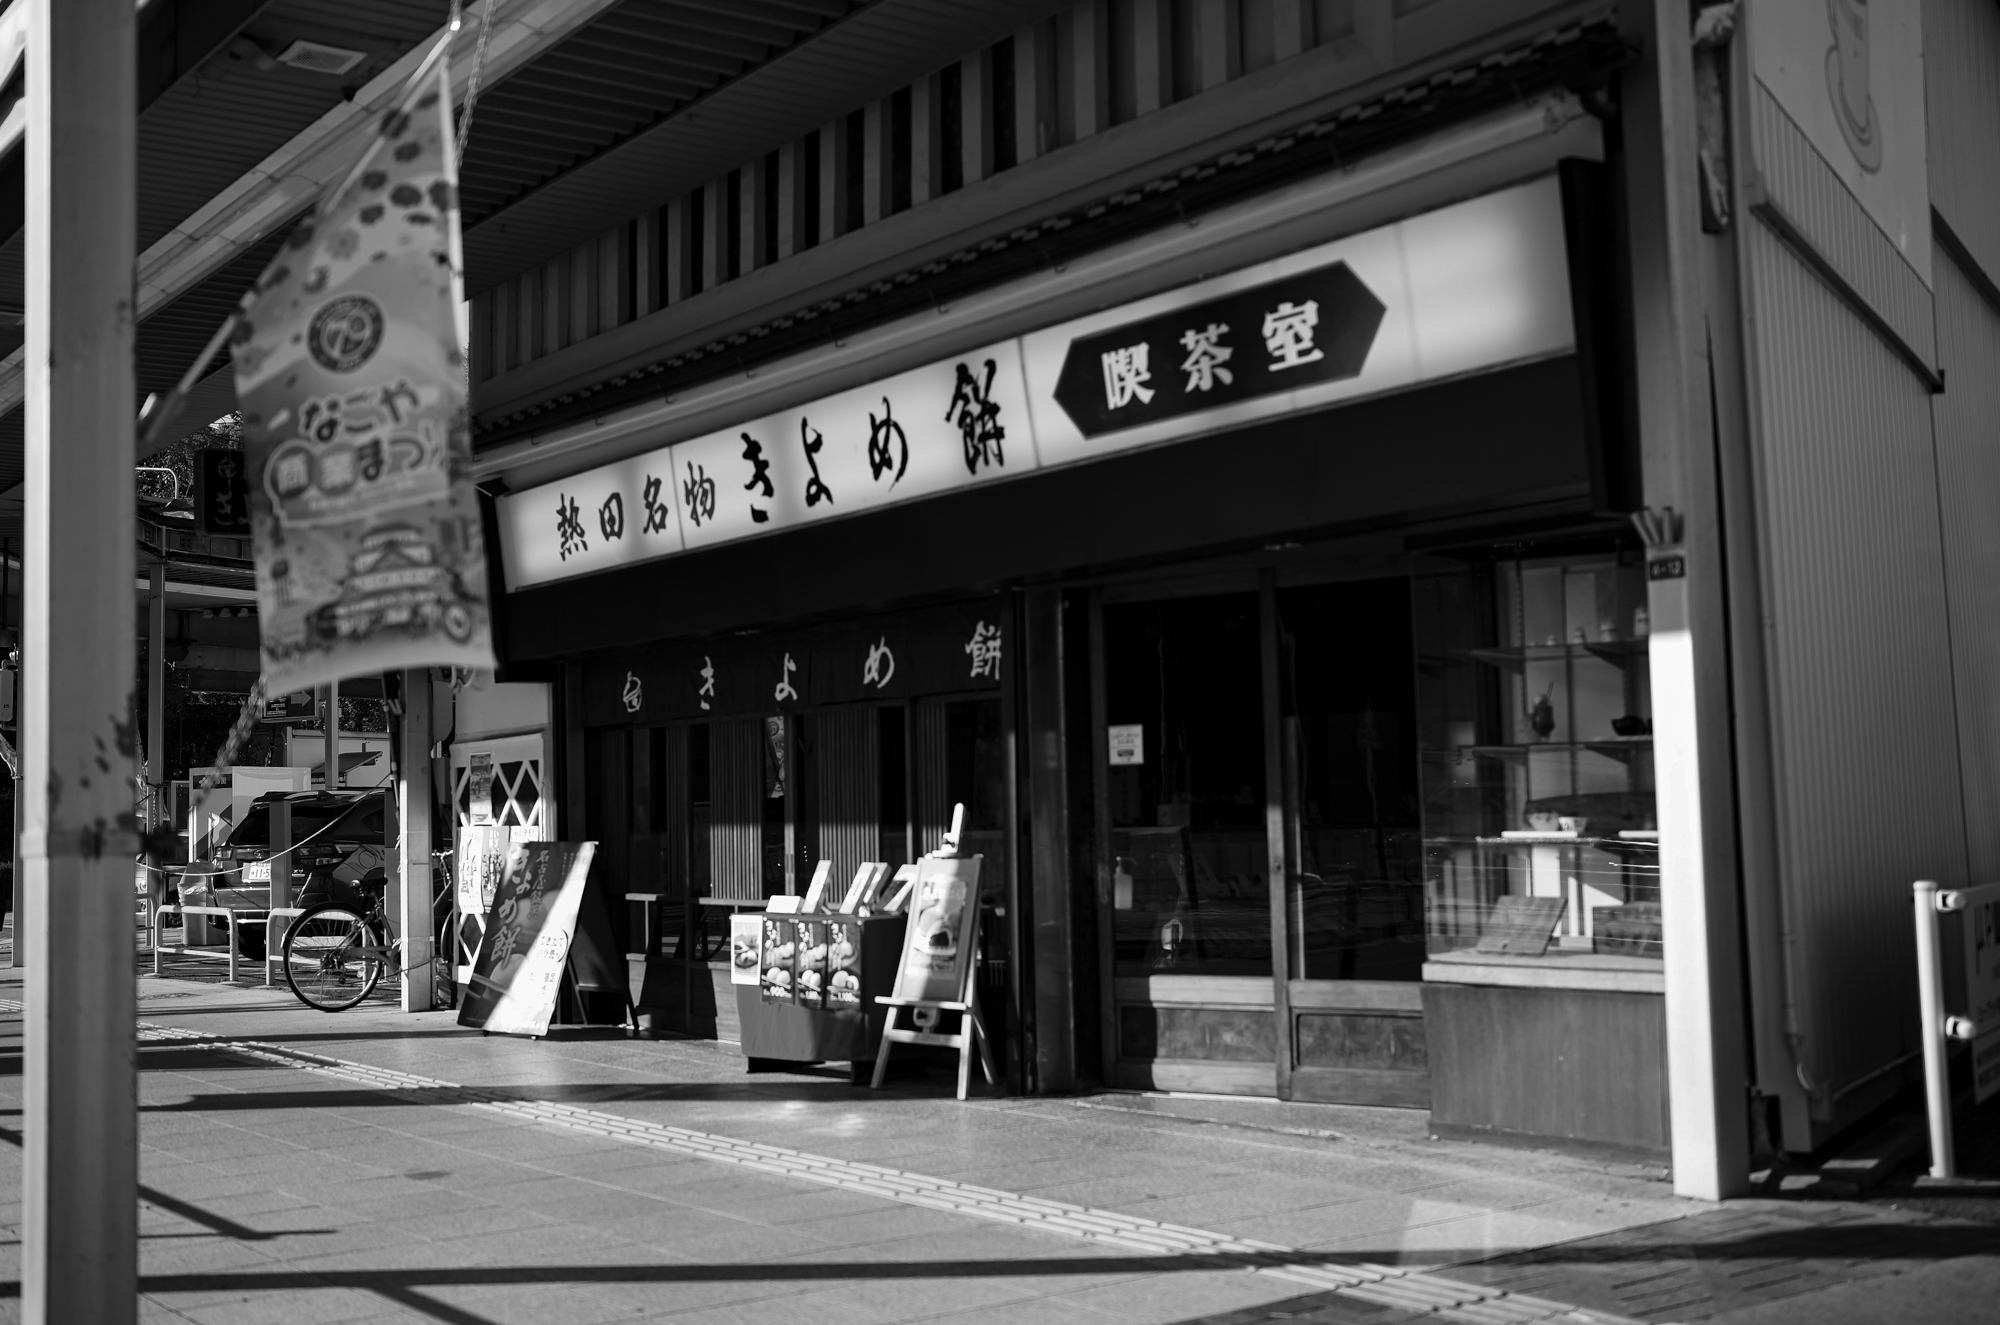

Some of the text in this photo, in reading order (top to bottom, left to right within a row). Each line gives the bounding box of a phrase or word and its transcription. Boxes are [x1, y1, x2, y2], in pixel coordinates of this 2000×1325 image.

[1101, 300, 1323, 410] 喫茶室
[556, 357, 1005, 562] 熱田名物 きよめ餅
[699, 621, 1002, 711] きよめ餅
